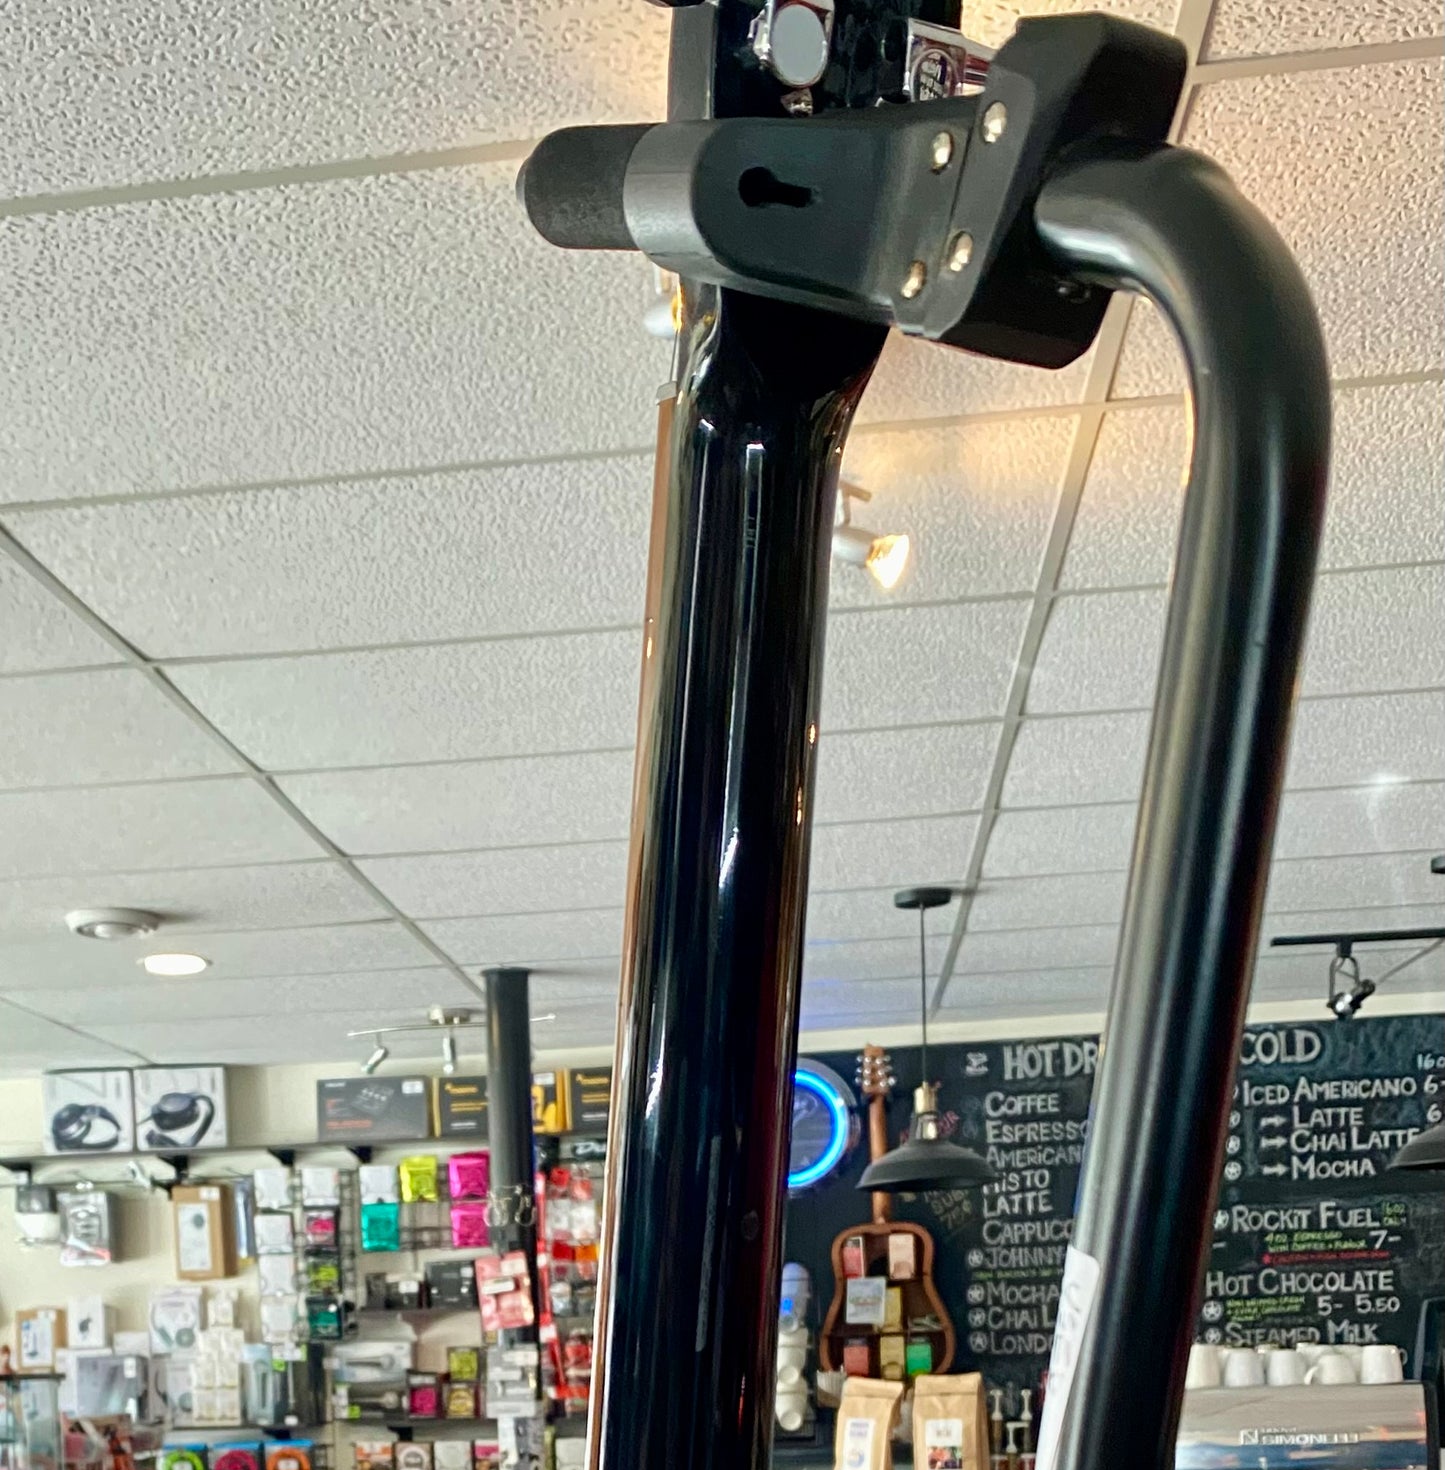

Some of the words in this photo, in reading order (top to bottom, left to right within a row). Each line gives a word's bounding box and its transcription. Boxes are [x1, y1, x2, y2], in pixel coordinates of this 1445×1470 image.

[1239, 1029, 1322, 1065] COLD
[1003, 1042, 1060, 1081] HOT
[1061, 1041, 1099, 1077] DR
[985, 1091, 1060, 1118] COFFEE
[1242, 1079, 1291, 1107] ICED
[1292, 1105, 1364, 1129] LATTE
[985, 1145, 1083, 1169] AMERiCAN
[1291, 1155, 1377, 1180] MOCHA
[982, 1189, 1054, 1219] LATTE
[1319, 1201, 1381, 1230] FUEL
[982, 1218, 1074, 1245] CAPPUCC
[986, 1281, 1060, 1305] MOCHA
[1205, 1270, 1254, 1297] HOT
[1258, 1268, 1394, 1295] CHOCOLATE
[1041, 1304, 1057, 1328] L
[1355, 1294, 1401, 1314] 5.50
[989, 1331, 1055, 1355] LOND
[1224, 1322, 1320, 1347] STEAMED
